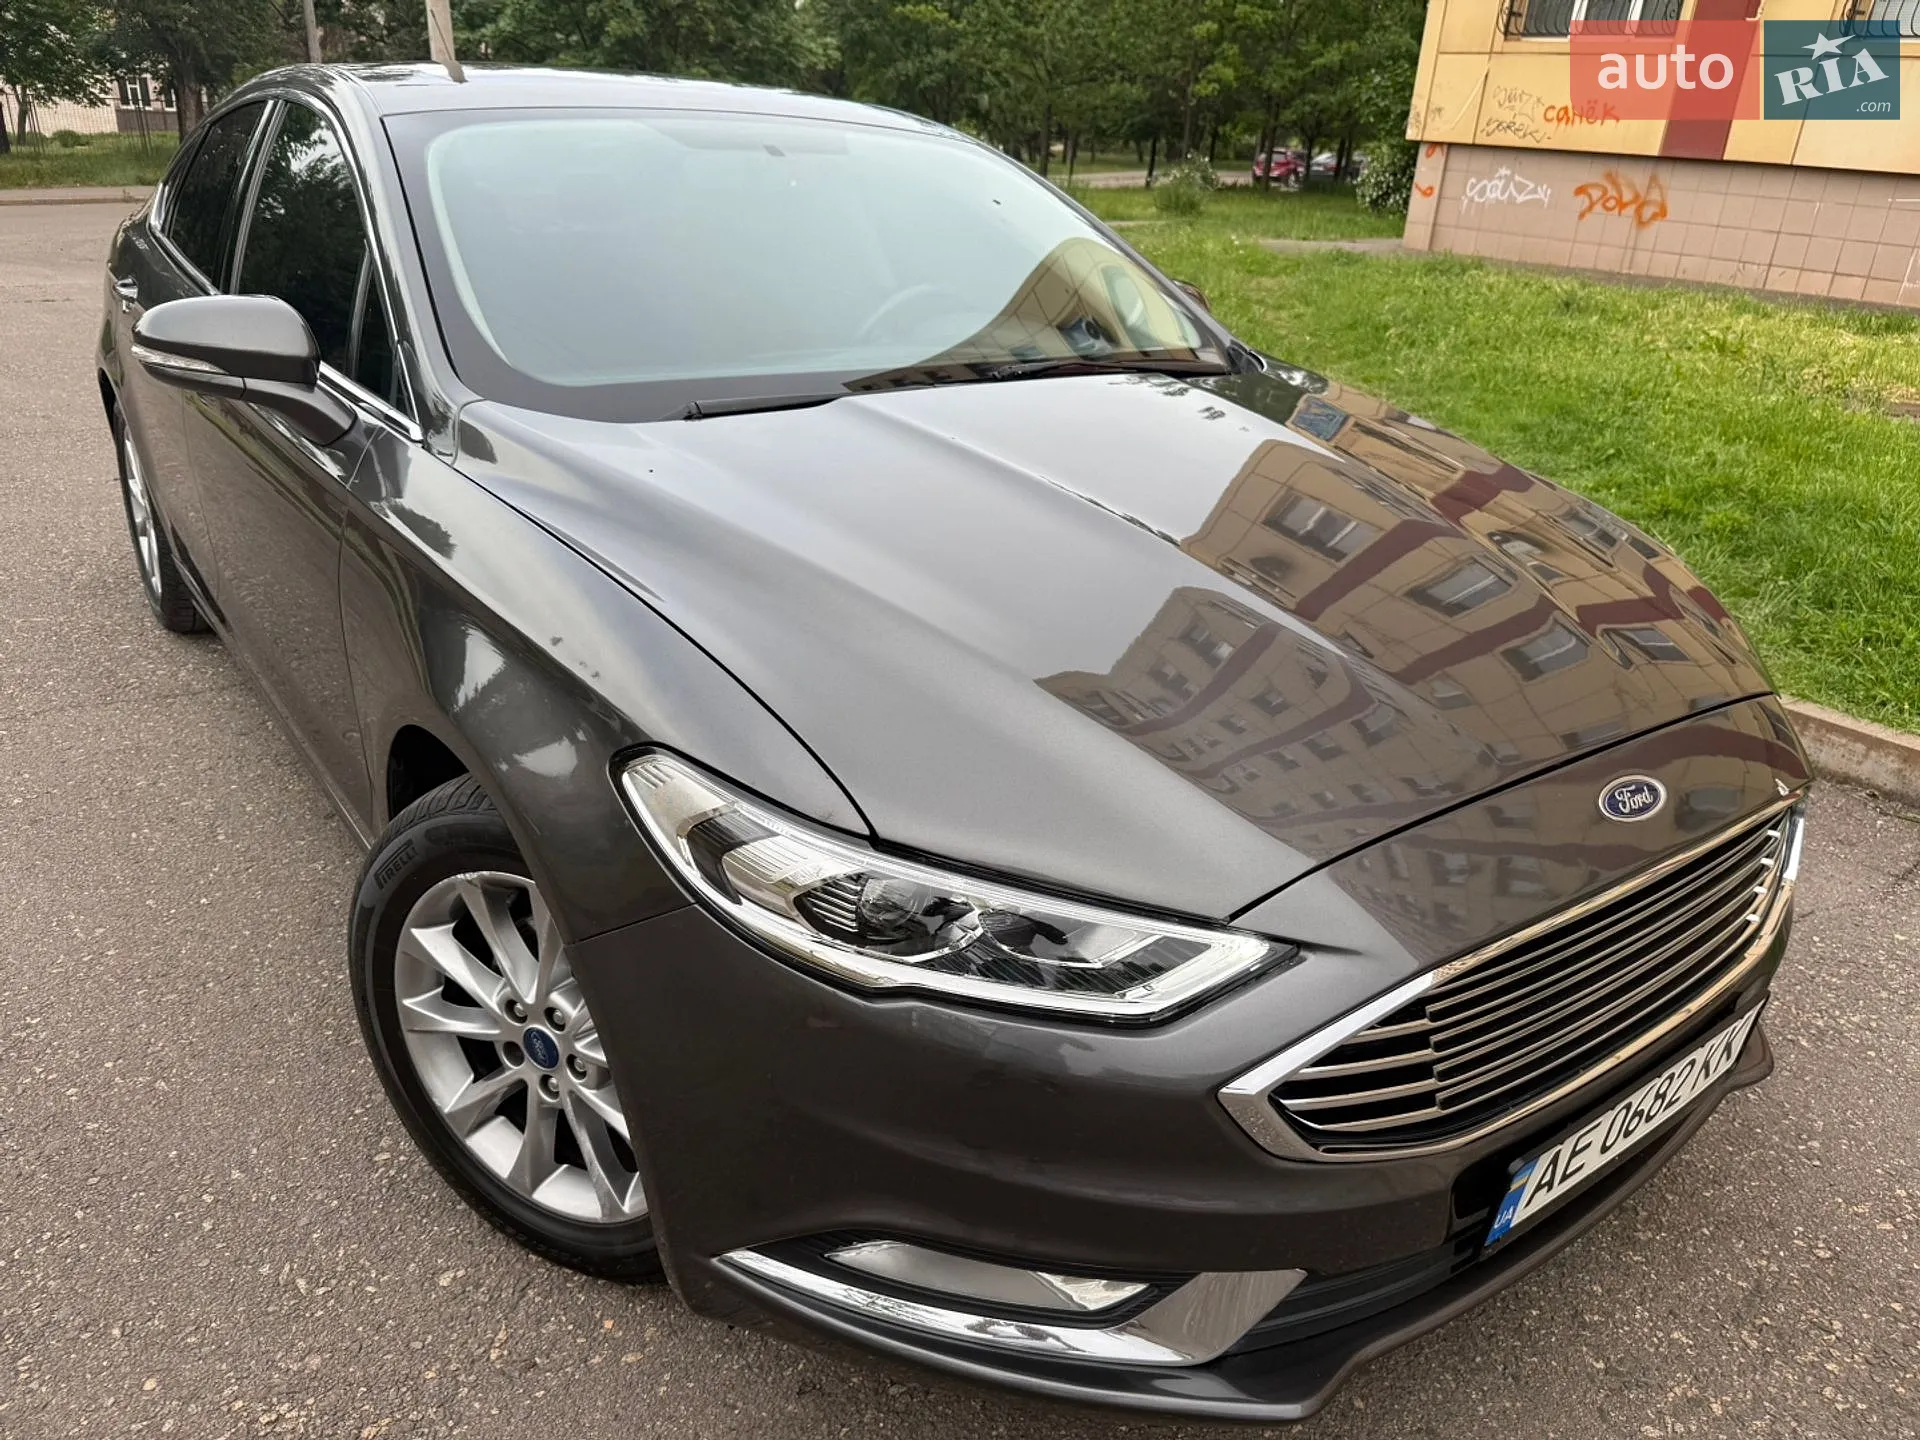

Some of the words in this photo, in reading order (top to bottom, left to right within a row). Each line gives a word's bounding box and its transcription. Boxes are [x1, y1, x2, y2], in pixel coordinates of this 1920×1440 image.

[1614, 784, 1654, 813] Ford
[374, 838, 419, 890] PIRELLI
[1522, 1121, 1600, 1210] AE
[1599, 1057, 1697, 1156] 0682
[1690, 1012, 1752, 1092] KK
